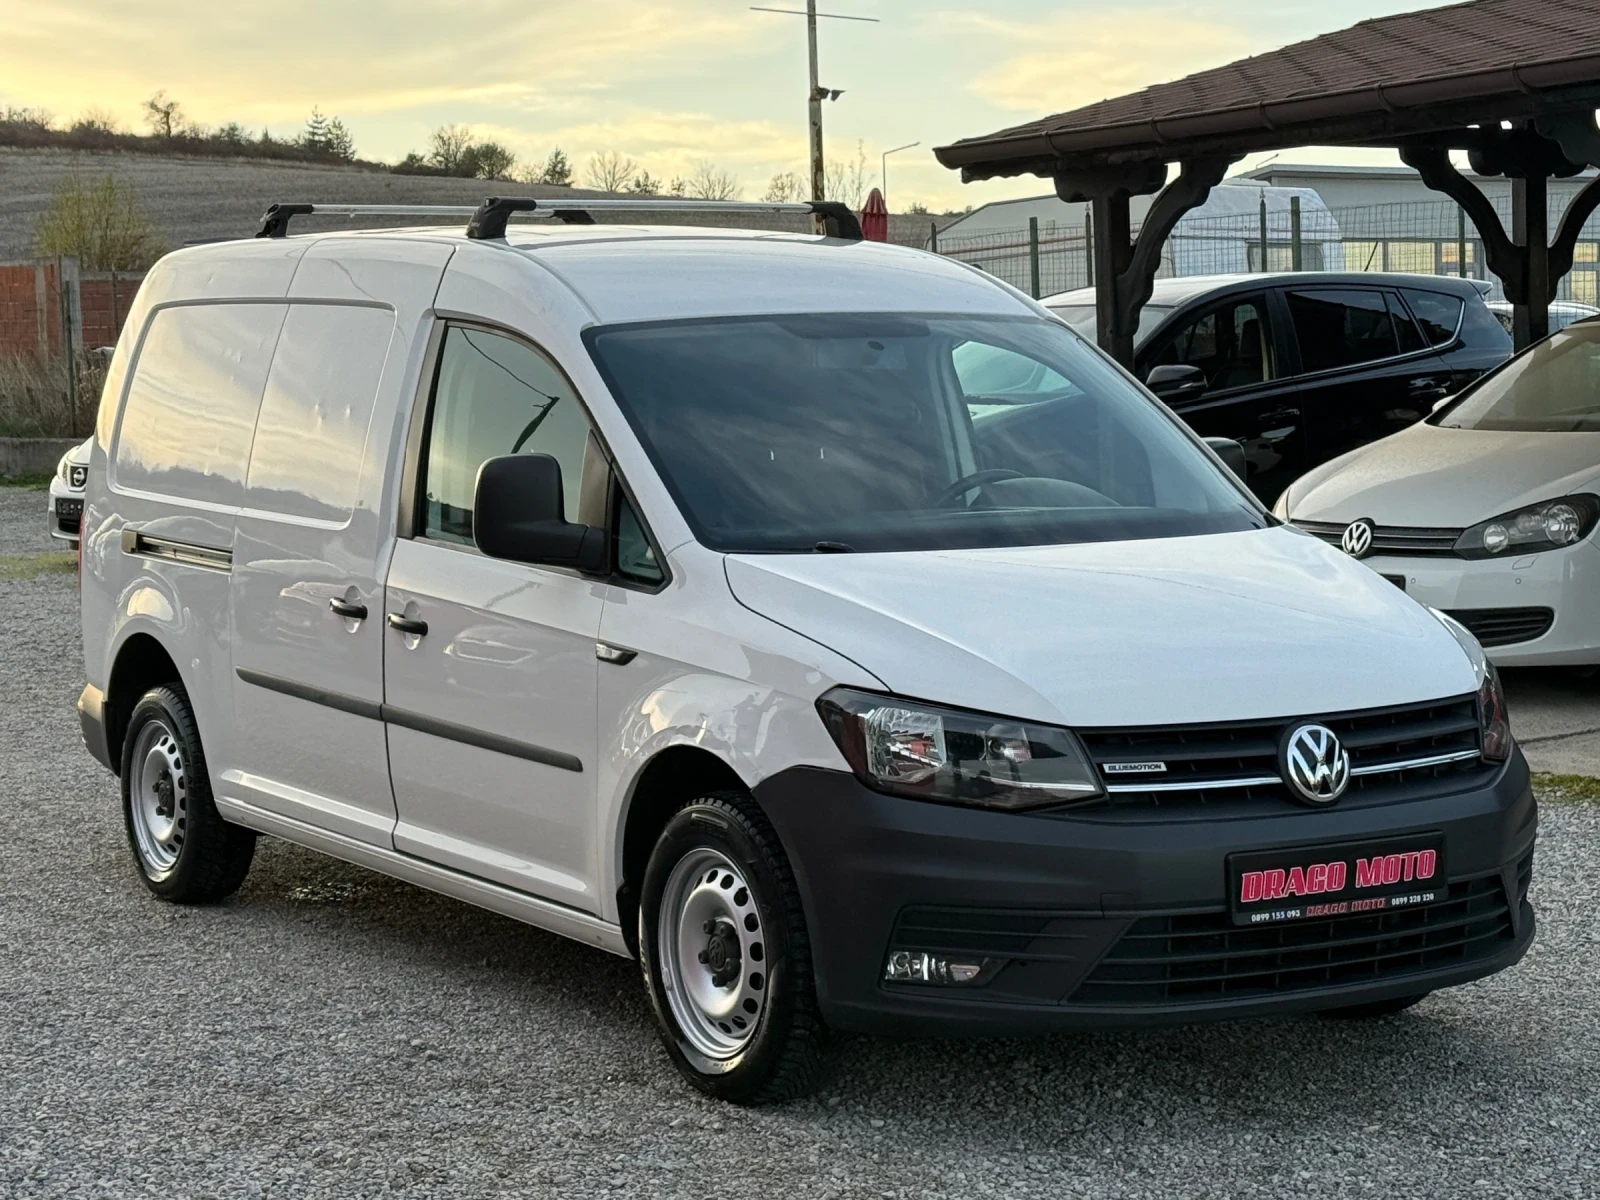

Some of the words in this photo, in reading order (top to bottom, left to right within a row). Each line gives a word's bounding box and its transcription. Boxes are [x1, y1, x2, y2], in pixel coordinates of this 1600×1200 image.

[1108, 763, 1162, 771] BLUEMOTION
[1287, 724, 1350, 803] VW
[1240, 861, 1347, 903] DRAGO
[1355, 849, 1436, 888] MOTO
[1306, 902, 1348, 917] DRAGO
[1351, 897, 1386, 912] MOTO
[1391, 896, 1408, 906] 0899
[1251, 912, 1270, 922] 0899
[1271, 911, 1285, 920] 155
[1286, 909, 1300, 918] 093
